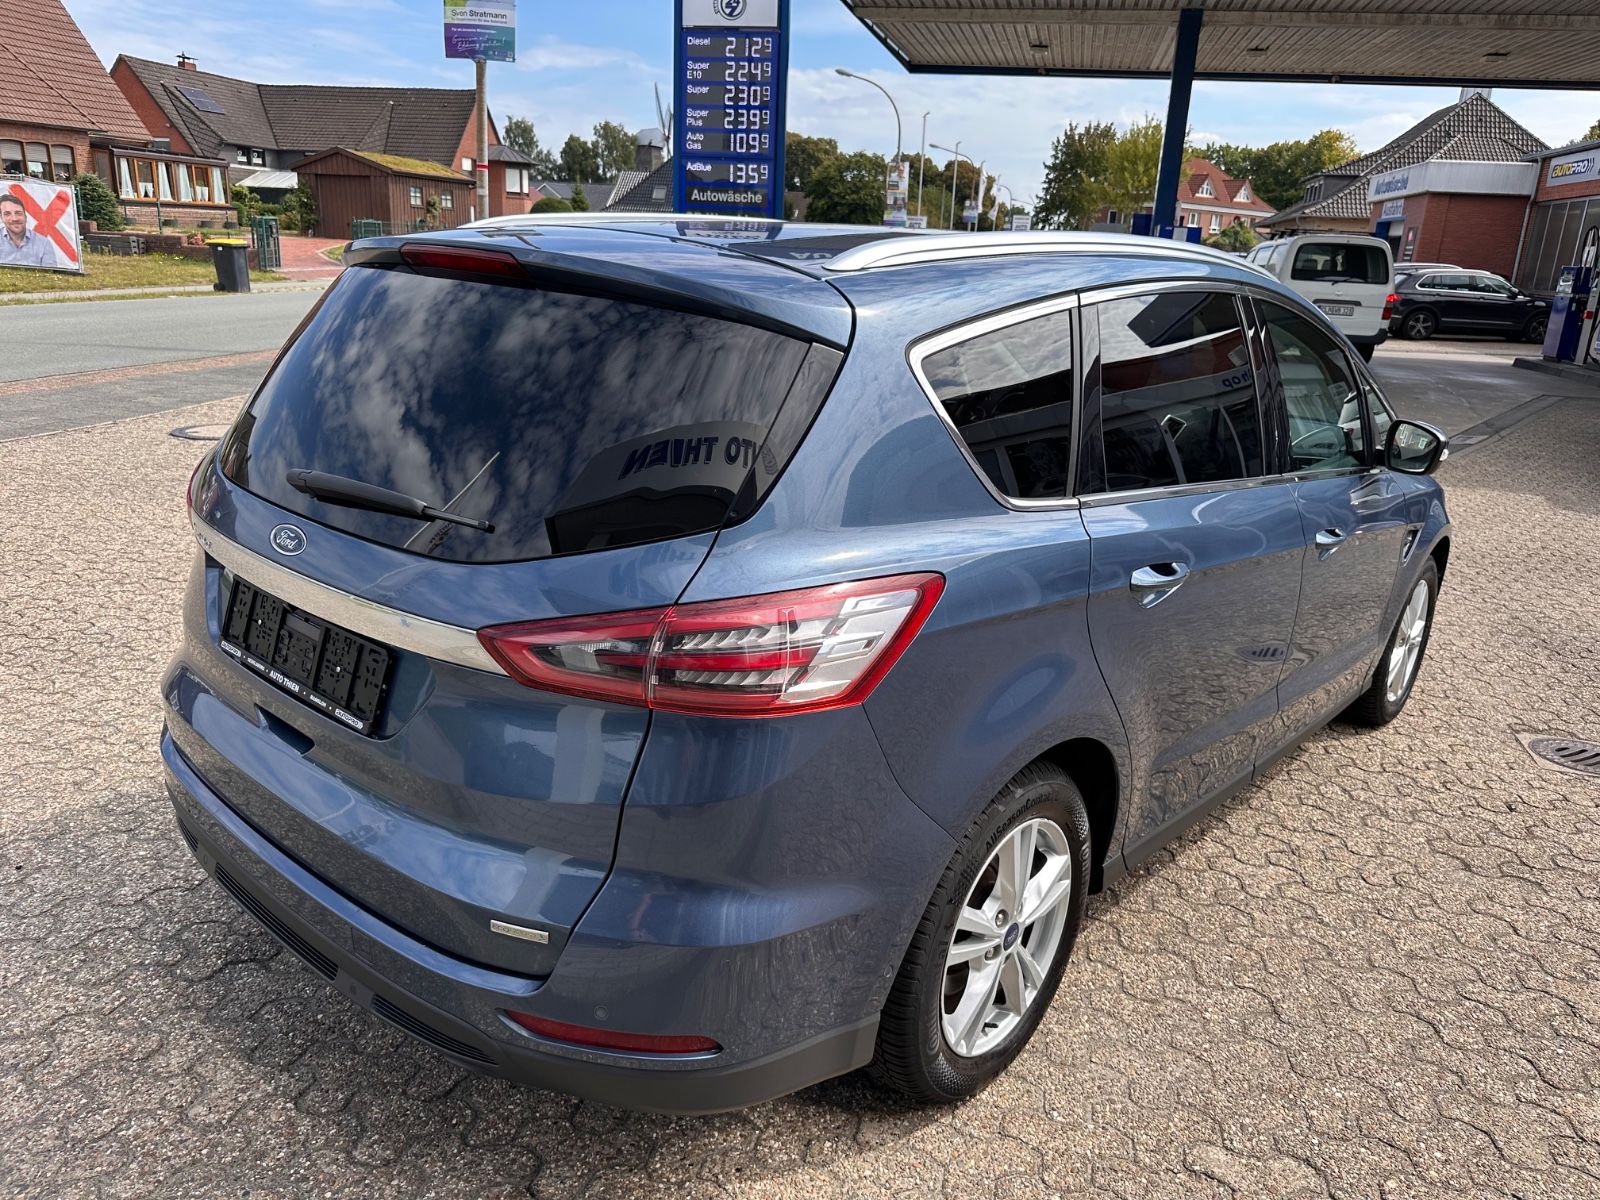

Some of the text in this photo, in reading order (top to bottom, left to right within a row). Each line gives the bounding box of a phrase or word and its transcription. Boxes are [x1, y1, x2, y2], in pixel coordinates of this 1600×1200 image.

[451, 9, 507, 19] Sven Stratmann
[686, 36, 773, 58] Diesel 2129
[686, 60, 772, 82] Super 2249
[686, 71, 703, 80] E10
[686, 84, 771, 106] Super 2309
[686, 108, 710, 118] Super
[686, 108, 770, 130] Plus 2399
[686, 131, 770, 154] Auto 1099
[686, 142, 702, 150] Gas
[686, 161, 769, 184] AdBlue 1359
[691, 188, 763, 203] Autowäsche
[276, 529, 299, 550] Ford
[269, 669, 300, 693] AUTO THIEN
